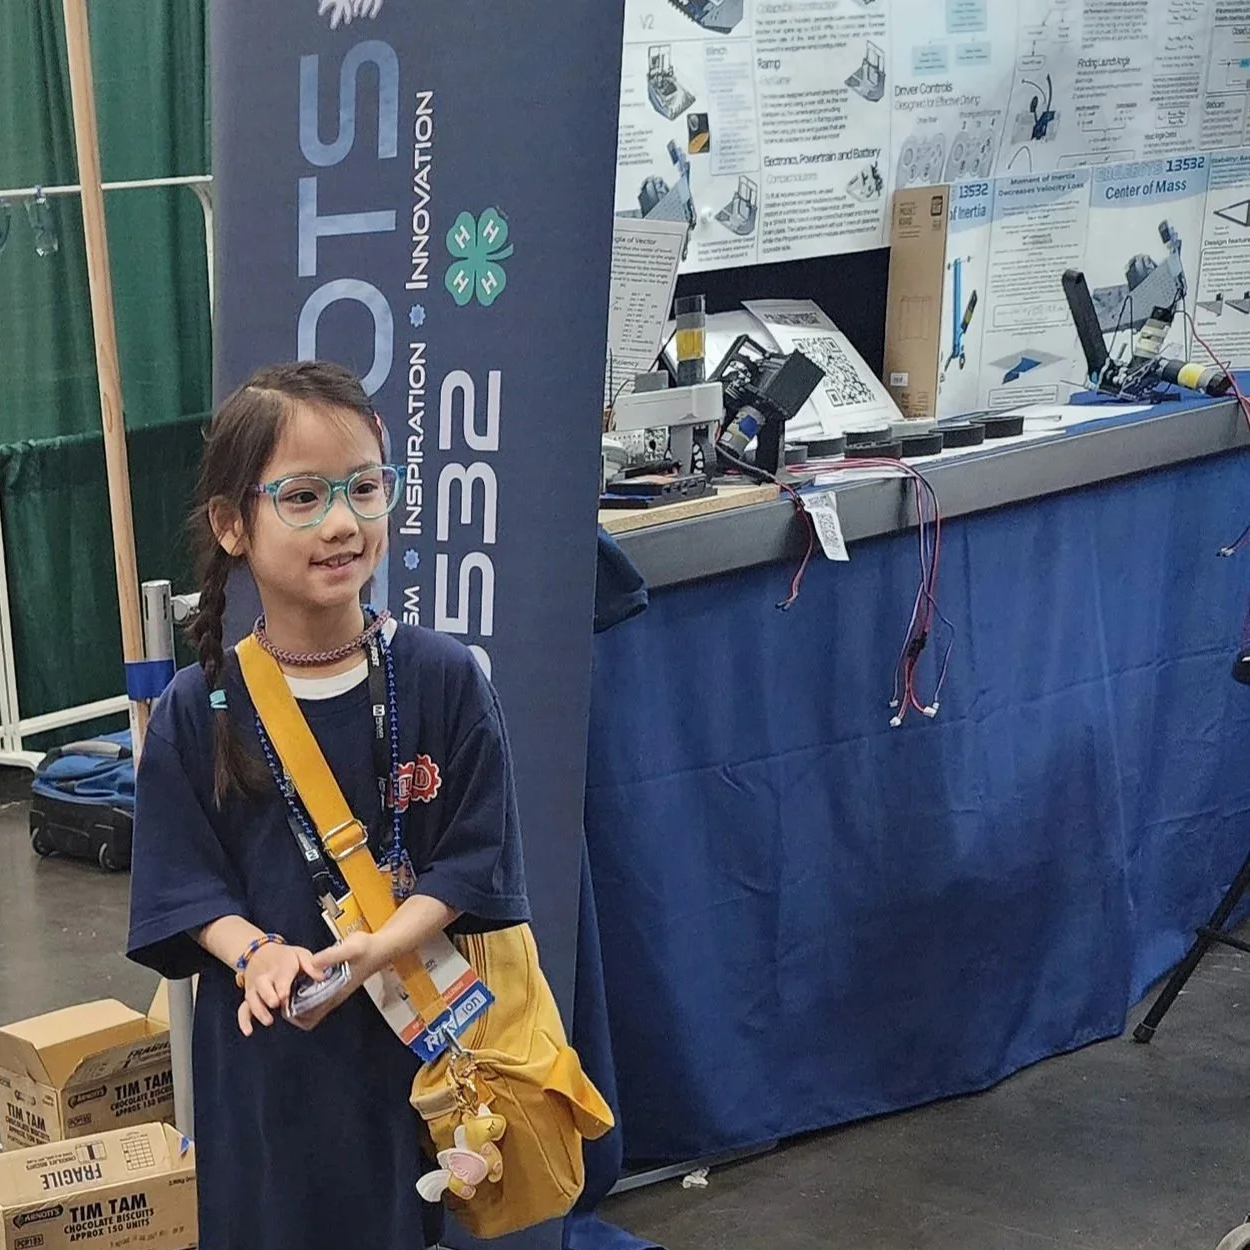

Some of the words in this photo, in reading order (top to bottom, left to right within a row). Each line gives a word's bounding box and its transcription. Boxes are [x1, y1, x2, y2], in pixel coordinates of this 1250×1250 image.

[894, 84, 918, 96] Driver
[920, 82, 953, 95] Controls
[1165, 156, 1205, 172] 13532
[405, 90, 434, 290] INNOVATION
[958, 183, 989, 199] 13532
[1105, 185, 1140, 200] Center
[1142, 180, 1155, 195] of
[1156, 180, 1187, 194] Mass
[297, 40, 399, 397] OTS
[958, 204, 986, 219] Inertia
[455, 225, 471, 249] H
[483, 219, 500, 244] H
[453, 269, 470, 294] H
[481, 270, 498, 295] H
[400, 342, 427, 535] INSPIRATION
[115, 1080, 140, 1100] TIM
[144, 1070, 173, 1091] TAM
[7, 1102, 23, 1122] TIM
[26, 1110, 46, 1132] TAM
[40, 1162, 103, 1191] FRAGILE
[69, 1202, 103, 1223] TIM
[108, 1193, 147, 1214] TAM
[63, 1216, 114, 1235] CHOCOLATE
[116, 1207, 155, 1223] BISCUITS
[69, 1228, 104, 1243] APPROX
[108, 1224, 124, 1235] 150
[126, 1218, 150, 1231] UNITS
